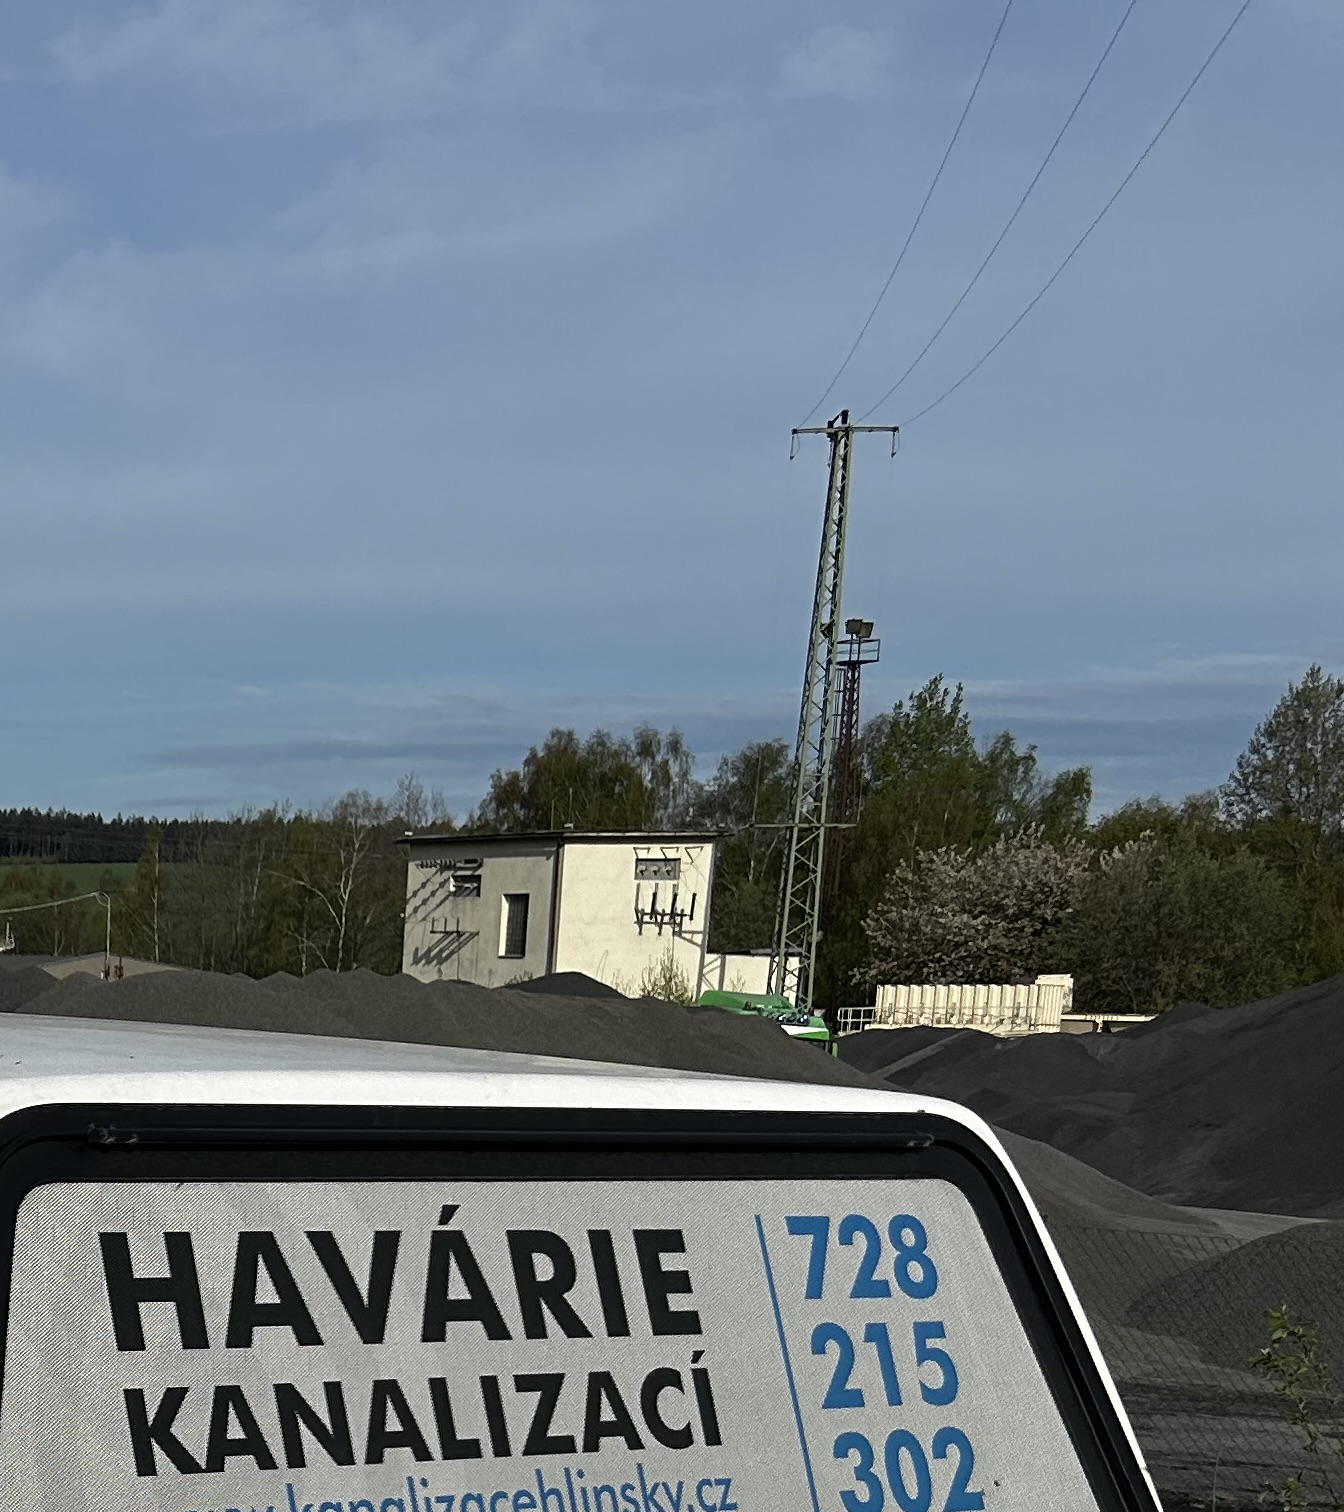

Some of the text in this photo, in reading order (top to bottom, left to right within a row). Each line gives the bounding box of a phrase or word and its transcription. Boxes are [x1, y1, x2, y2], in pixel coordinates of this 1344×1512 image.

[98, 1205, 704, 1353] HAVÁRIE
[786, 1213, 940, 1302] 728
[122, 1351, 724, 1478] KANALIZACÍ
[810, 1320, 960, 1411] 215
